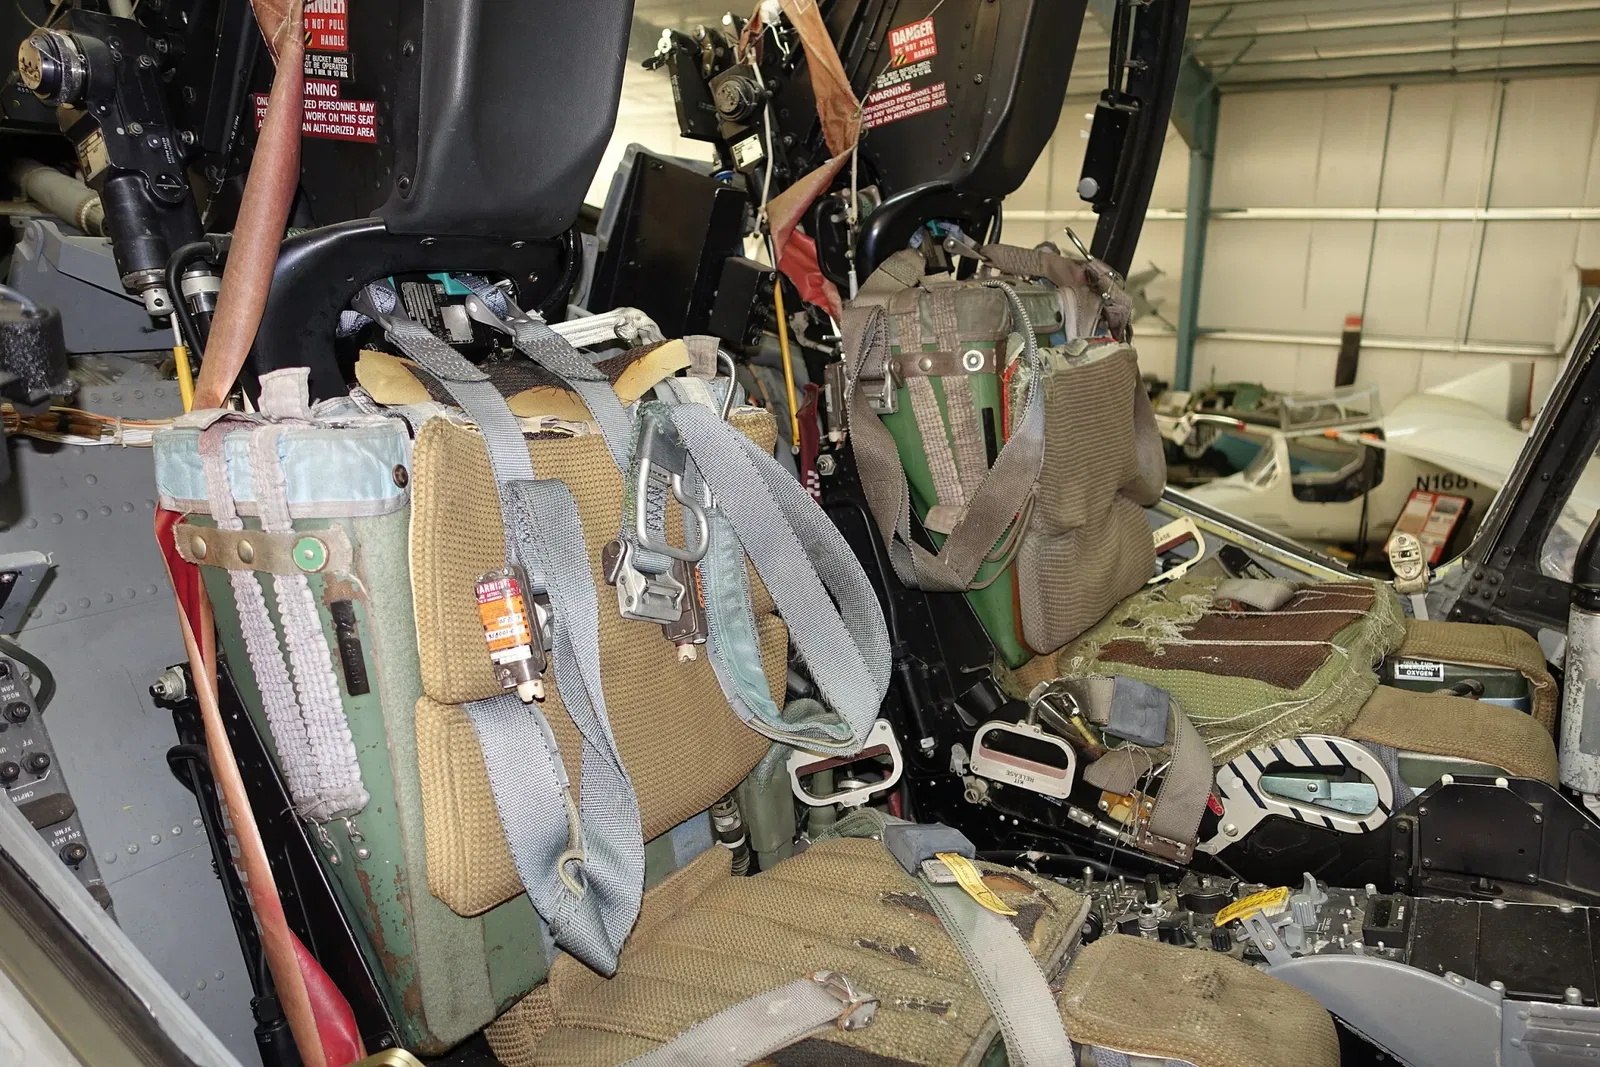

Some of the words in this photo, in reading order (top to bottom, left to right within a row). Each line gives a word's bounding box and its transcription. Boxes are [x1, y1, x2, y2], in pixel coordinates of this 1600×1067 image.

[304, 0, 345, 14] ANGER
[312, 18, 325, 29] NOT
[329, 19, 345, 30] PULL
[892, 20, 934, 46] DANGER
[320, 34, 345, 46] HANDLE
[920, 37, 934, 47] PULL
[312, 55, 332, 63] BUCKET
[322, 62, 348, 71] OPERATED
[304, 82, 338, 97] RNING
[870, 83, 911, 103] WARNING
[863, 99, 896, 115] UTHORIZED
[896, 88, 931, 104] PERSONNEL
[931, 82, 945, 92] MAY
[873, 110, 885, 119] ANY
[886, 103, 906, 114] WORK
[906, 100, 916, 108] ON
[916, 96, 931, 105] THIS
[931, 90, 946, 98] SEAT
[318, 100, 358, 112] PERSONNEL
[360, 102, 375, 113] MAY
[305, 111, 327, 121] WORK
[328, 113, 339, 122] ON
[340, 114, 356, 124] THIS
[357, 115, 375, 125] SEAT
[863, 120, 876, 128] NLY
[883, 114, 893, 123] AN
[894, 103, 930, 119] AUTHORIZED
[931, 98, 948, 107] AREA
[302, 122, 312, 132] AN
[313, 124, 355, 136] AUTHORIZED
[356, 127, 375, 138] AREA
[0, 684, 14, 693] ARM
[2, 692, 20, 701] NOSE
[1006, 770, 1034, 782] RELEASE
[54, 826, 72, 837] XFMR
[68, 830, 81, 840] 26V
[51, 837, 67, 847] INST
